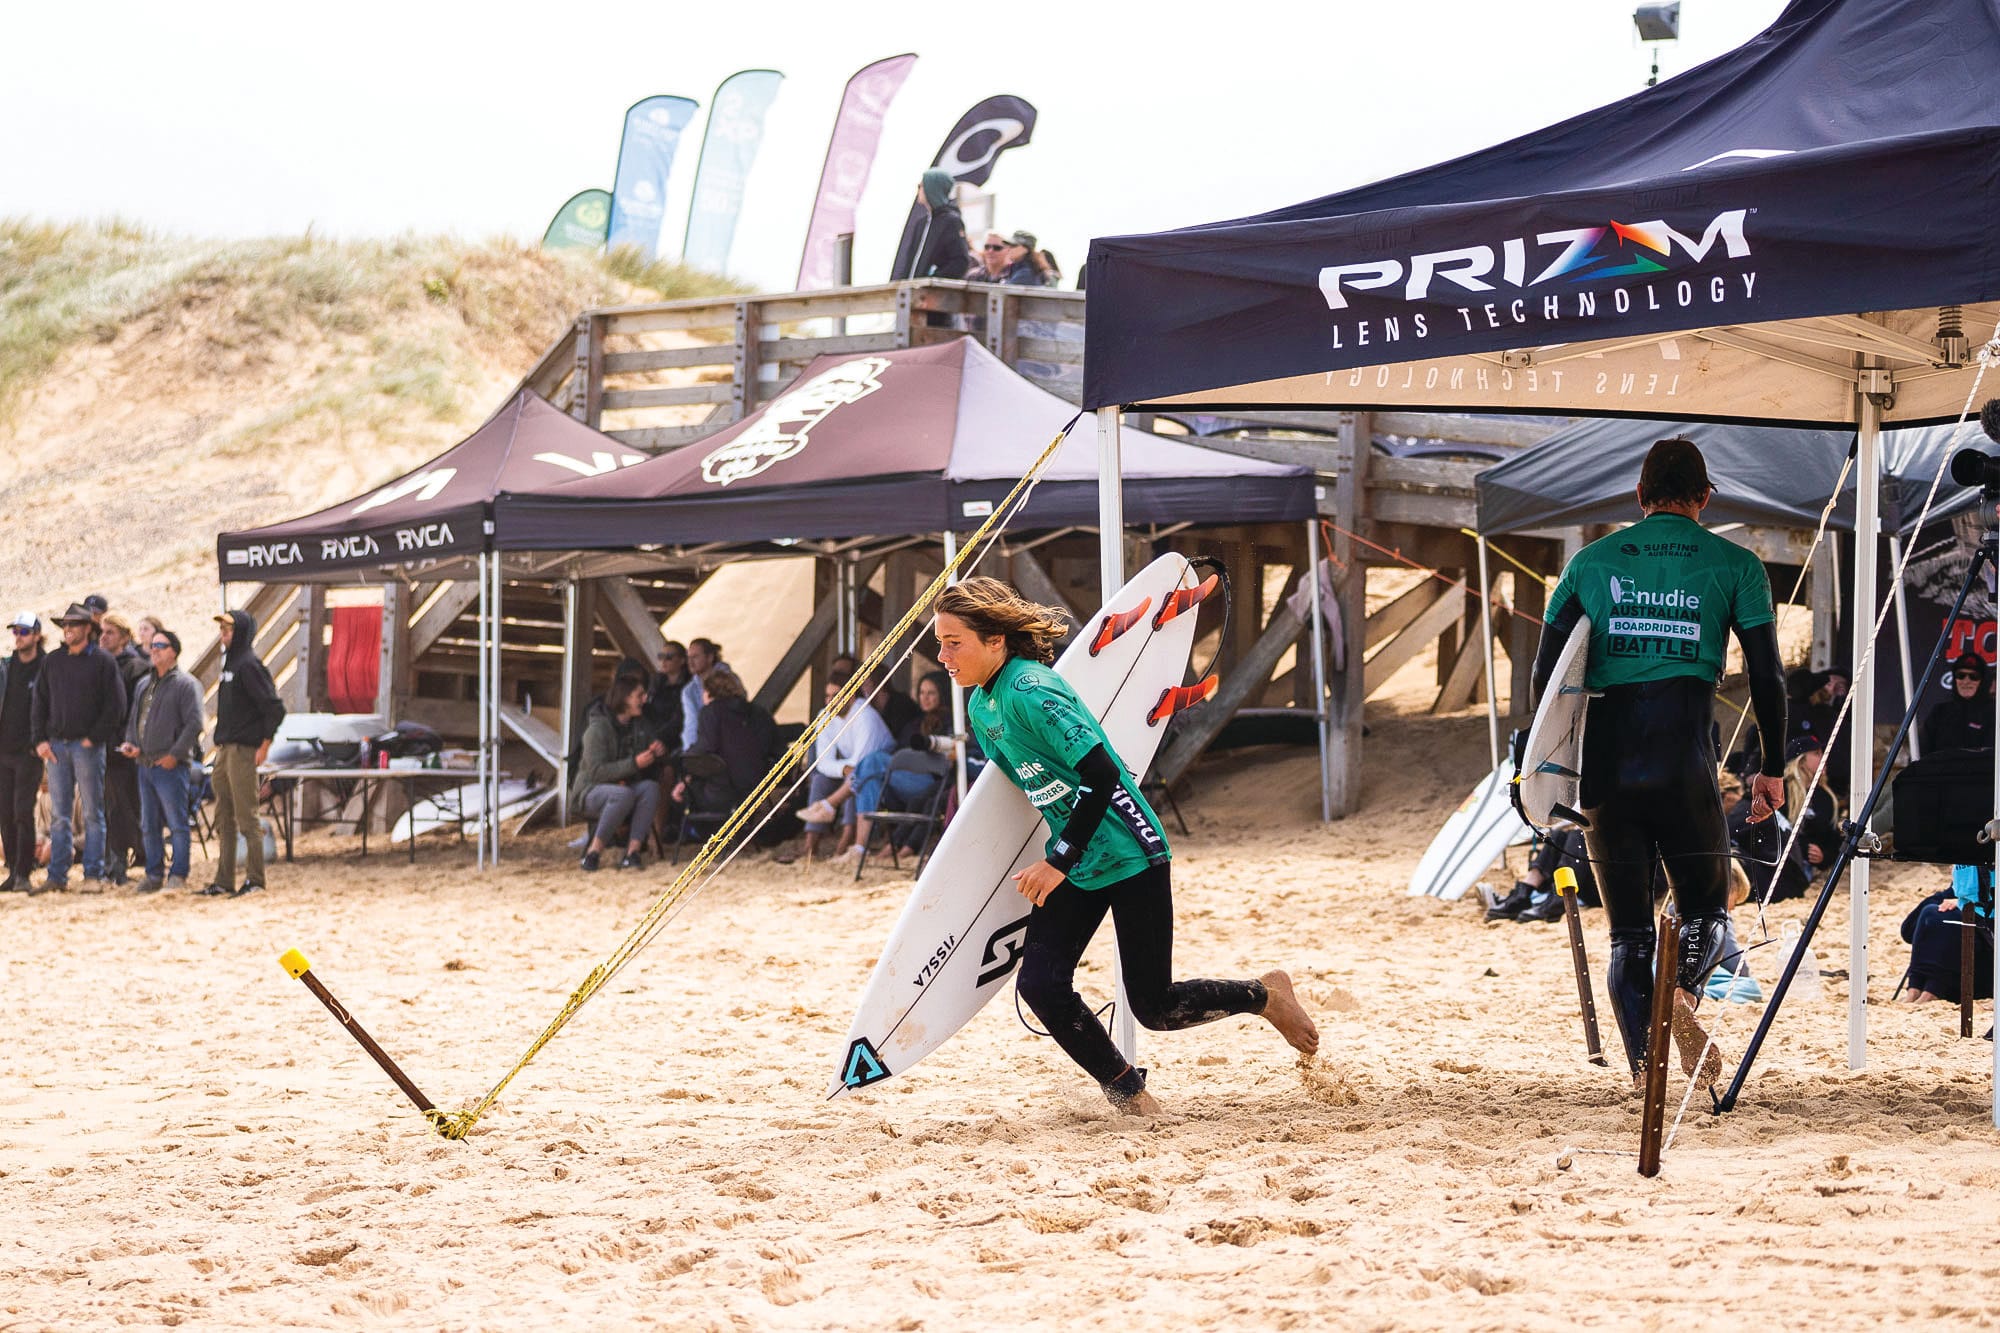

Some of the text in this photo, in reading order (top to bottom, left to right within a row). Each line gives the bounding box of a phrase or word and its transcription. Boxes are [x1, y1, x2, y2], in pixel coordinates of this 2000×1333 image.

[1318, 208, 1751, 310] PRIZM
[1332, 272, 1757, 349] LENS TECHNOLOGY
[248, 523, 455, 568] RVCA RVCA RVCA
[1643, 543, 1699, 553] SURFING
[1637, 589, 1700, 609] nudie
[1609, 605, 1701, 622] AUSTRALIAN
[1614, 621, 1695, 636] BOARDRIDERS
[1612, 636, 1695, 658] BATTLE
